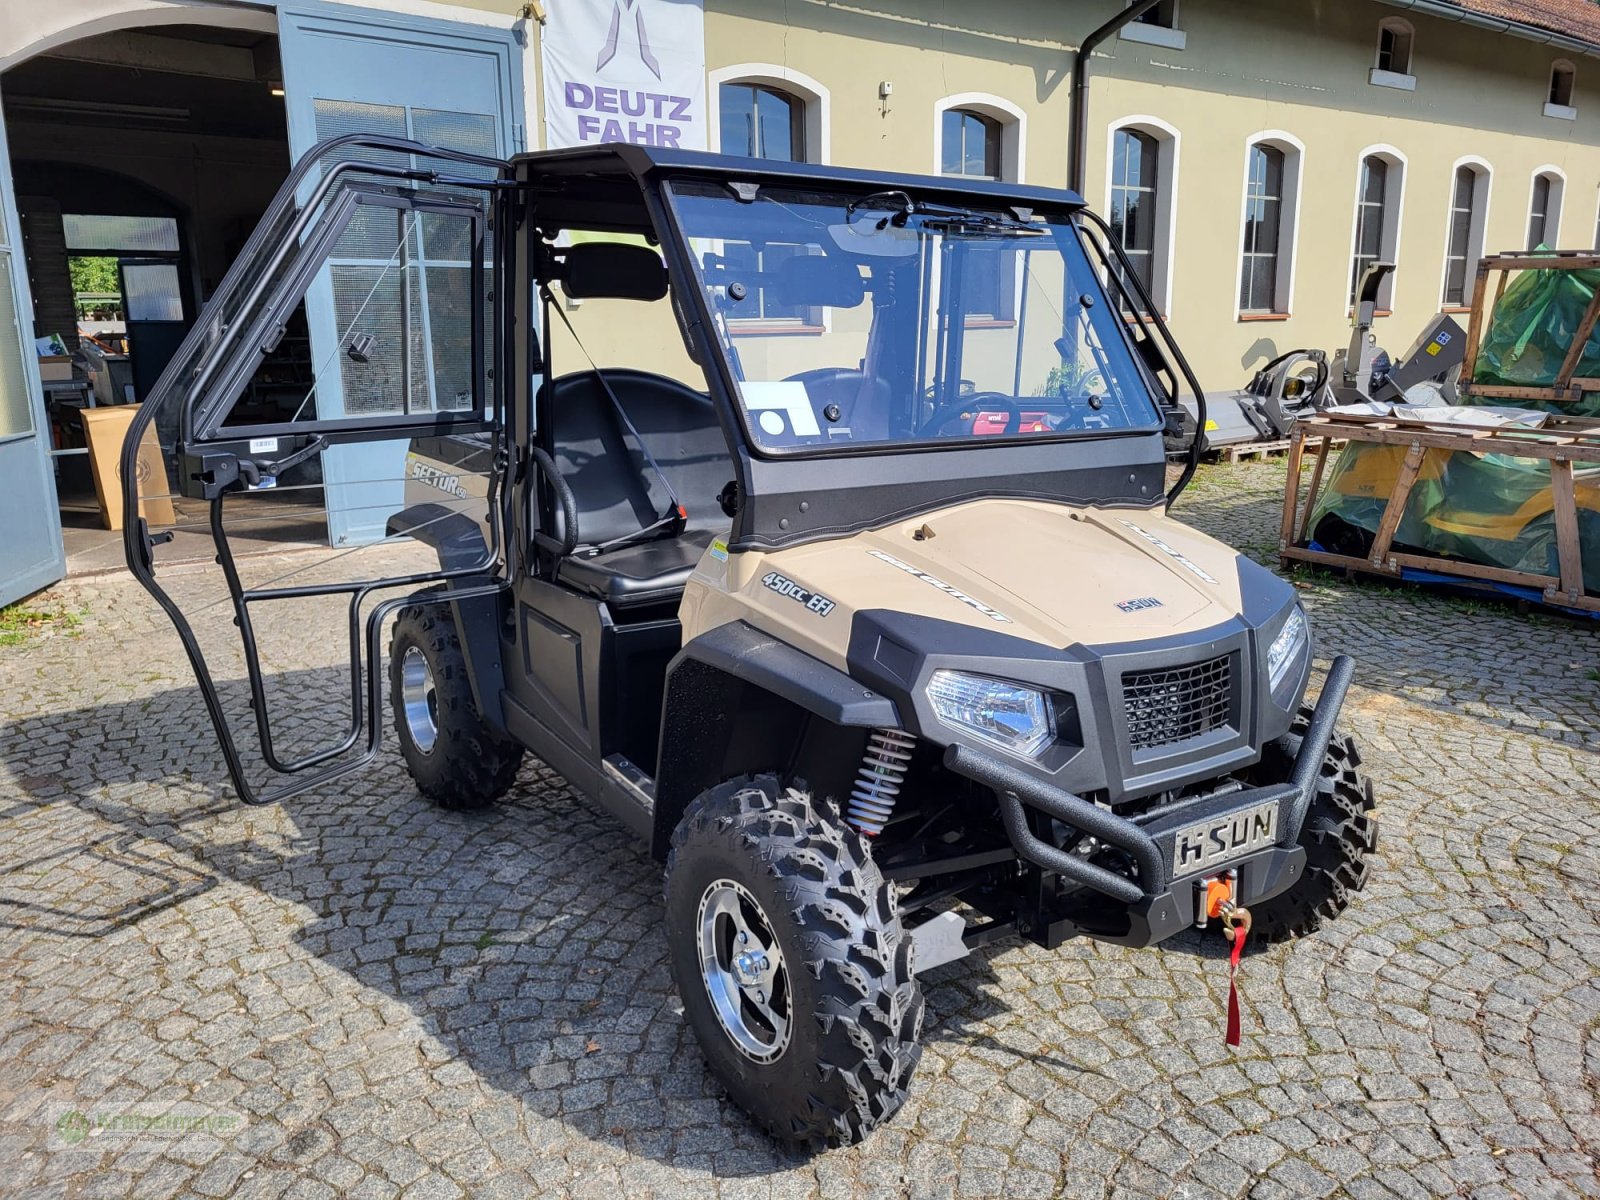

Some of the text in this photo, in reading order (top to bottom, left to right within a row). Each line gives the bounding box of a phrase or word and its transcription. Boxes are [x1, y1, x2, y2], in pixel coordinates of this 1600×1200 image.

[565, 81, 692, 122] DEUTZ
[578, 115, 681, 149] FAHR
[411, 462, 459, 495] SECTOR
[805, 593, 836, 617] EFI
